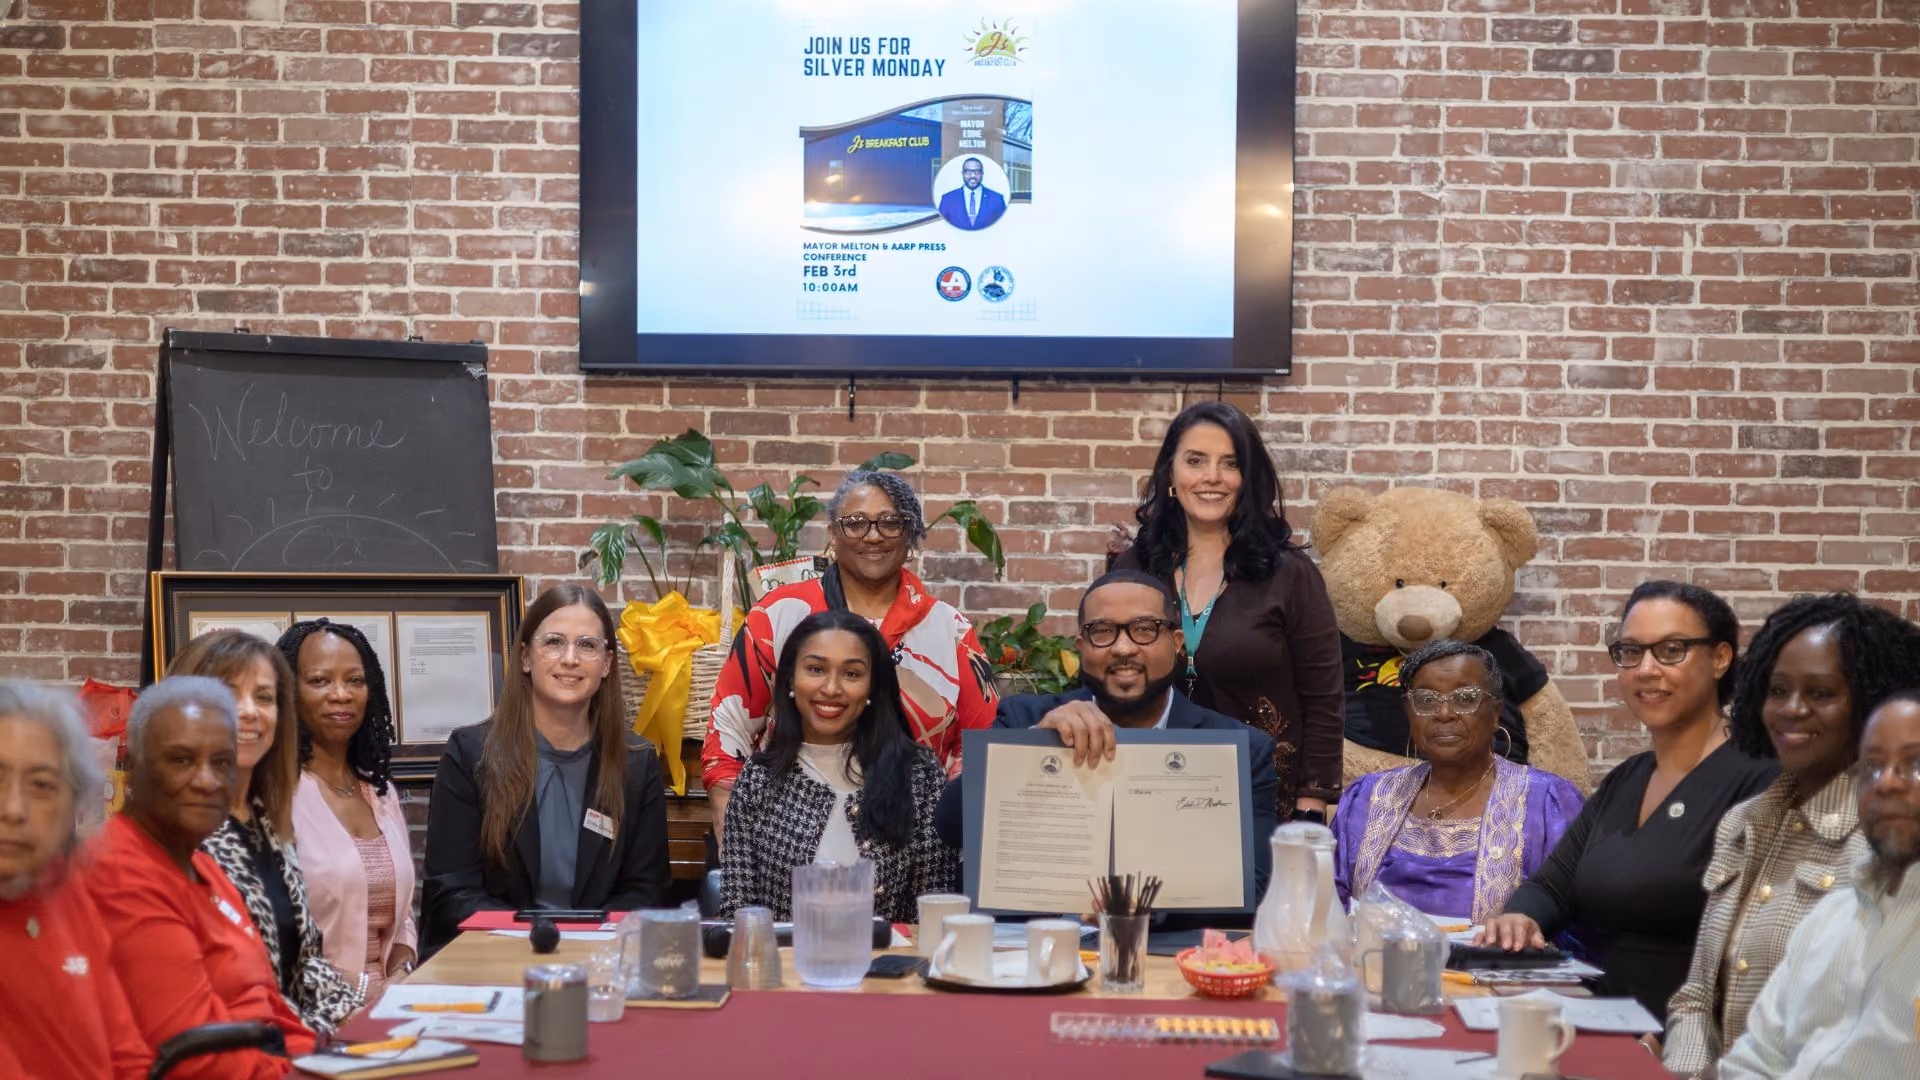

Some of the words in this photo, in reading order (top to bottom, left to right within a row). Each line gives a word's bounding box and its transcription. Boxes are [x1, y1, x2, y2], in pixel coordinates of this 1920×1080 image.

[804, 37, 842, 55] JOIN
[849, 37, 870, 55] US
[878, 37, 911, 55] FOR
[804, 58, 865, 76] SILVER
[872, 58, 945, 77] MONDAY
[865, 137, 907, 148] BREAKFAST
[908, 136, 930, 147] CLUB
[803, 242, 838, 250] MAYOR
[841, 242, 879, 250] MELTON
[891, 243, 916, 251] AARP
[918, 243, 946, 251] PRESS
[803, 253, 867, 261] CONFERENCE
[803, 265, 828, 277] FEB
[833, 263, 857, 277] 3rd
[803, 282, 858, 292] 10:00AM
[188, 381, 407, 462] Welcome
[292, 455, 333, 492] to
